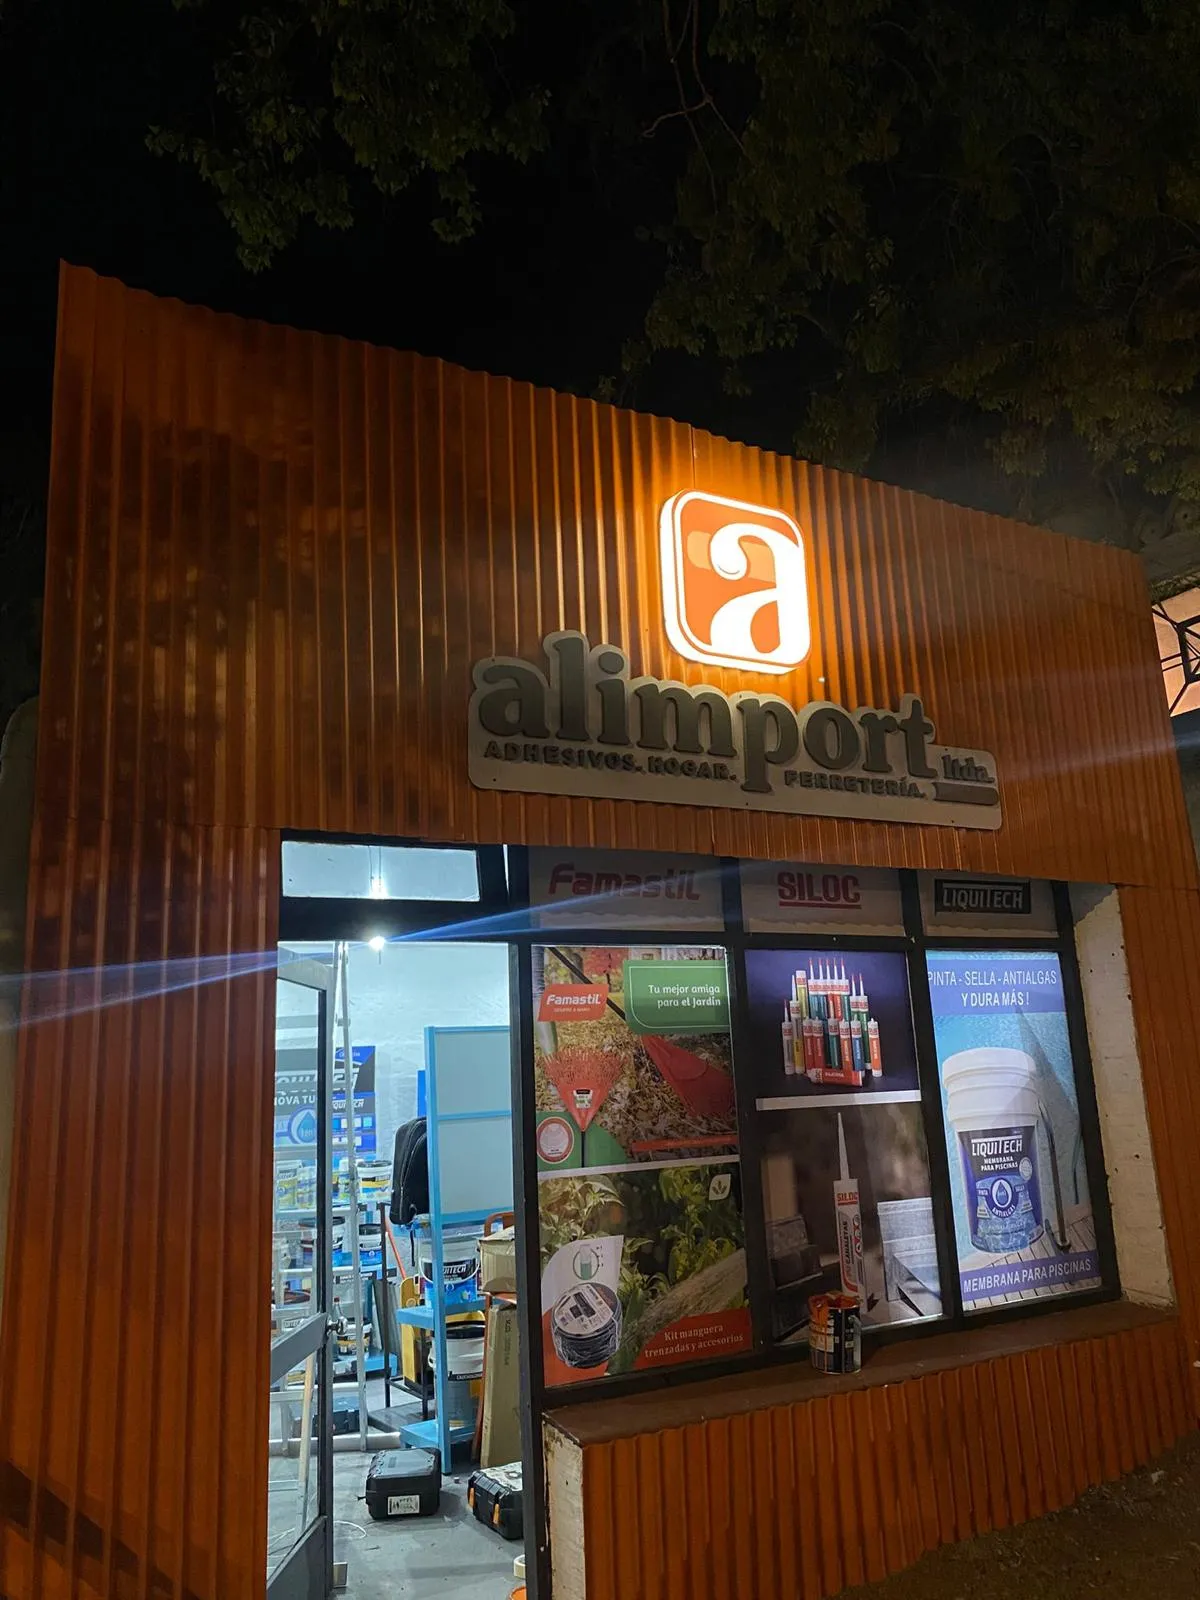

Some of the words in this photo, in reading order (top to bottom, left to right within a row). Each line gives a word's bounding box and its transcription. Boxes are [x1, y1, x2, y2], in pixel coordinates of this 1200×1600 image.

[710, 522, 811, 665] a
[478, 636, 937, 793] alimport
[547, 861, 700, 901] Famastil
[777, 871, 861, 904] SILOC
[943, 882, 1024, 909] LIQUITECH
[928, 971, 957, 986] PINTA
[965, 971, 996, 986] SELLA
[1003, 970, 1057, 985] ANTIALGAS
[546, 993, 602, 1006] Famastil
[648, 985, 660, 994] Tu
[663, 984, 690, 996] mejor
[691, 984, 721, 996] amiga
[961, 992, 969, 1007] Y
[970, 991, 1000, 1007] DURA
[1002, 989, 1024, 1006] MÁS
[657, 1000, 679, 1009] para
[681, 997, 691, 1007] el
[971, 1135, 1022, 1157] LIQUITECH
[995, 1161, 1018, 1170] PISCINAS
[837, 1192, 859, 1201] SILOC
[963, 1275, 1020, 1293] MEMBRANA
[1021, 1266, 1048, 1282] PARA
[1049, 1258, 1091, 1276] PISCINAS
[664, 1331, 678, 1341] Kit
[679, 1325, 724, 1339] manguera
[645, 1344, 690, 1358] trenzadas
[698, 1334, 744, 1349] accesorios
